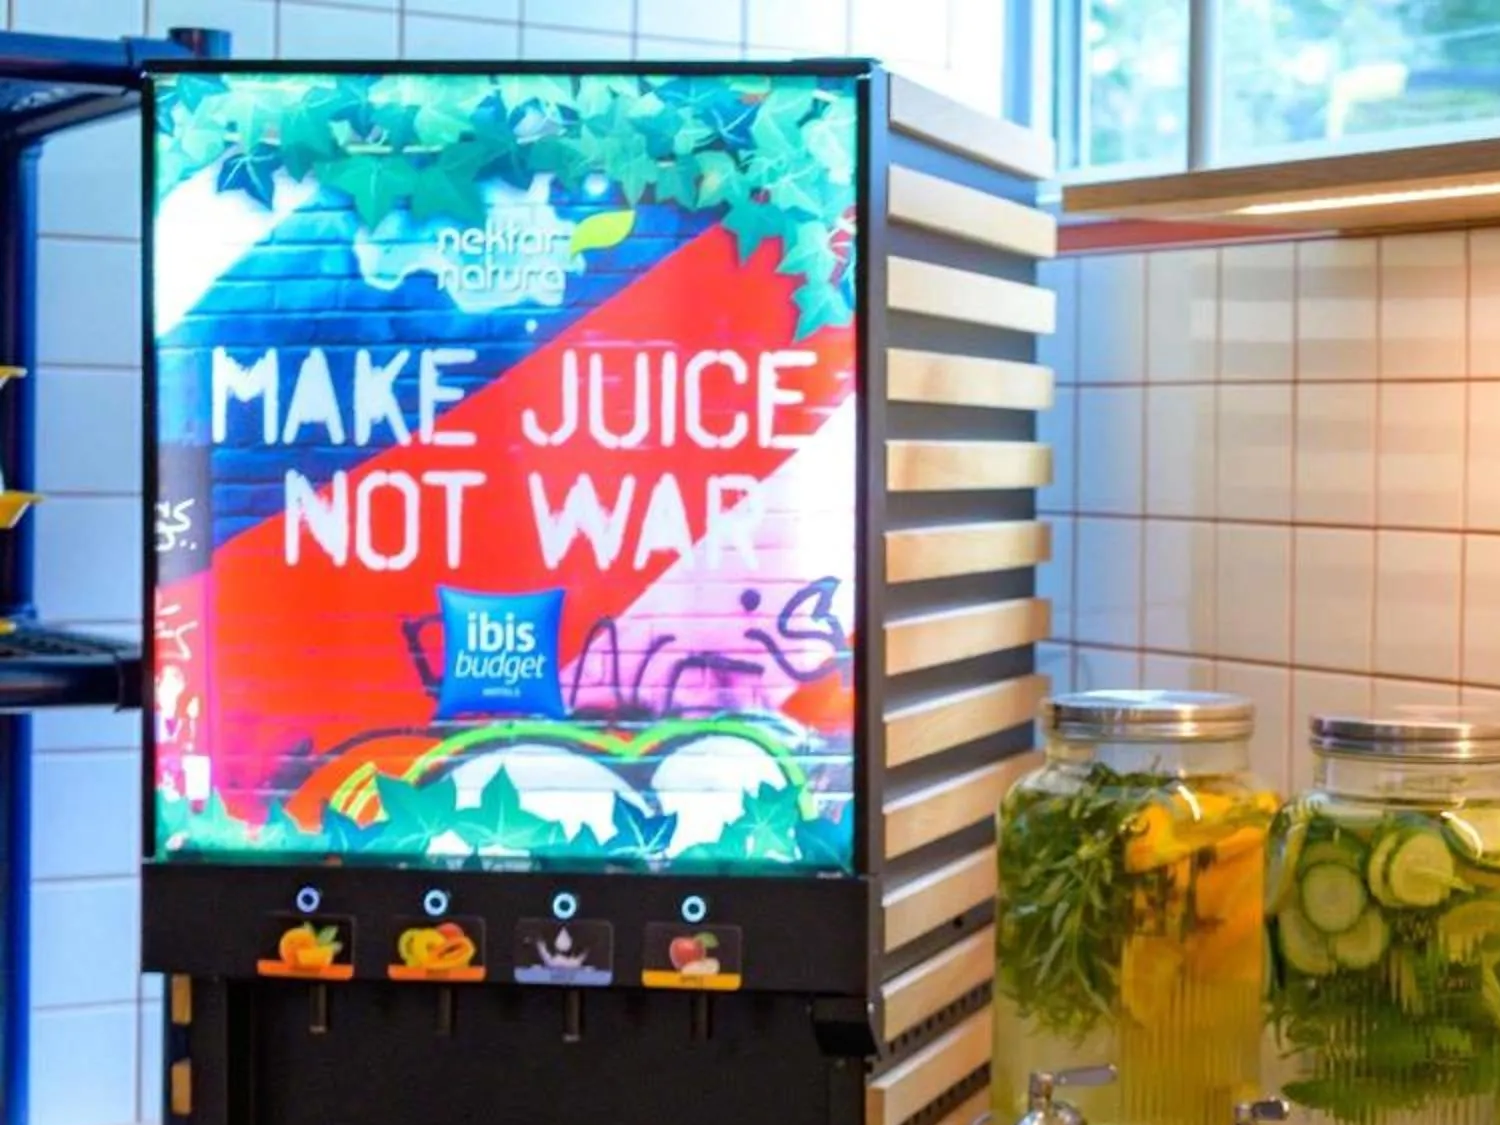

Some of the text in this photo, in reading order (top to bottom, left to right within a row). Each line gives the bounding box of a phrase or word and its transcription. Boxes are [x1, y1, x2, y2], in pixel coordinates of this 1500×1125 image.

[211, 346, 819, 449] MAKE JUICE
[283, 469, 487, 568] NOT
[528, 472, 766, 570] WAR
[454, 649, 546, 685] budget
[466, 611, 536, 653] ibis
